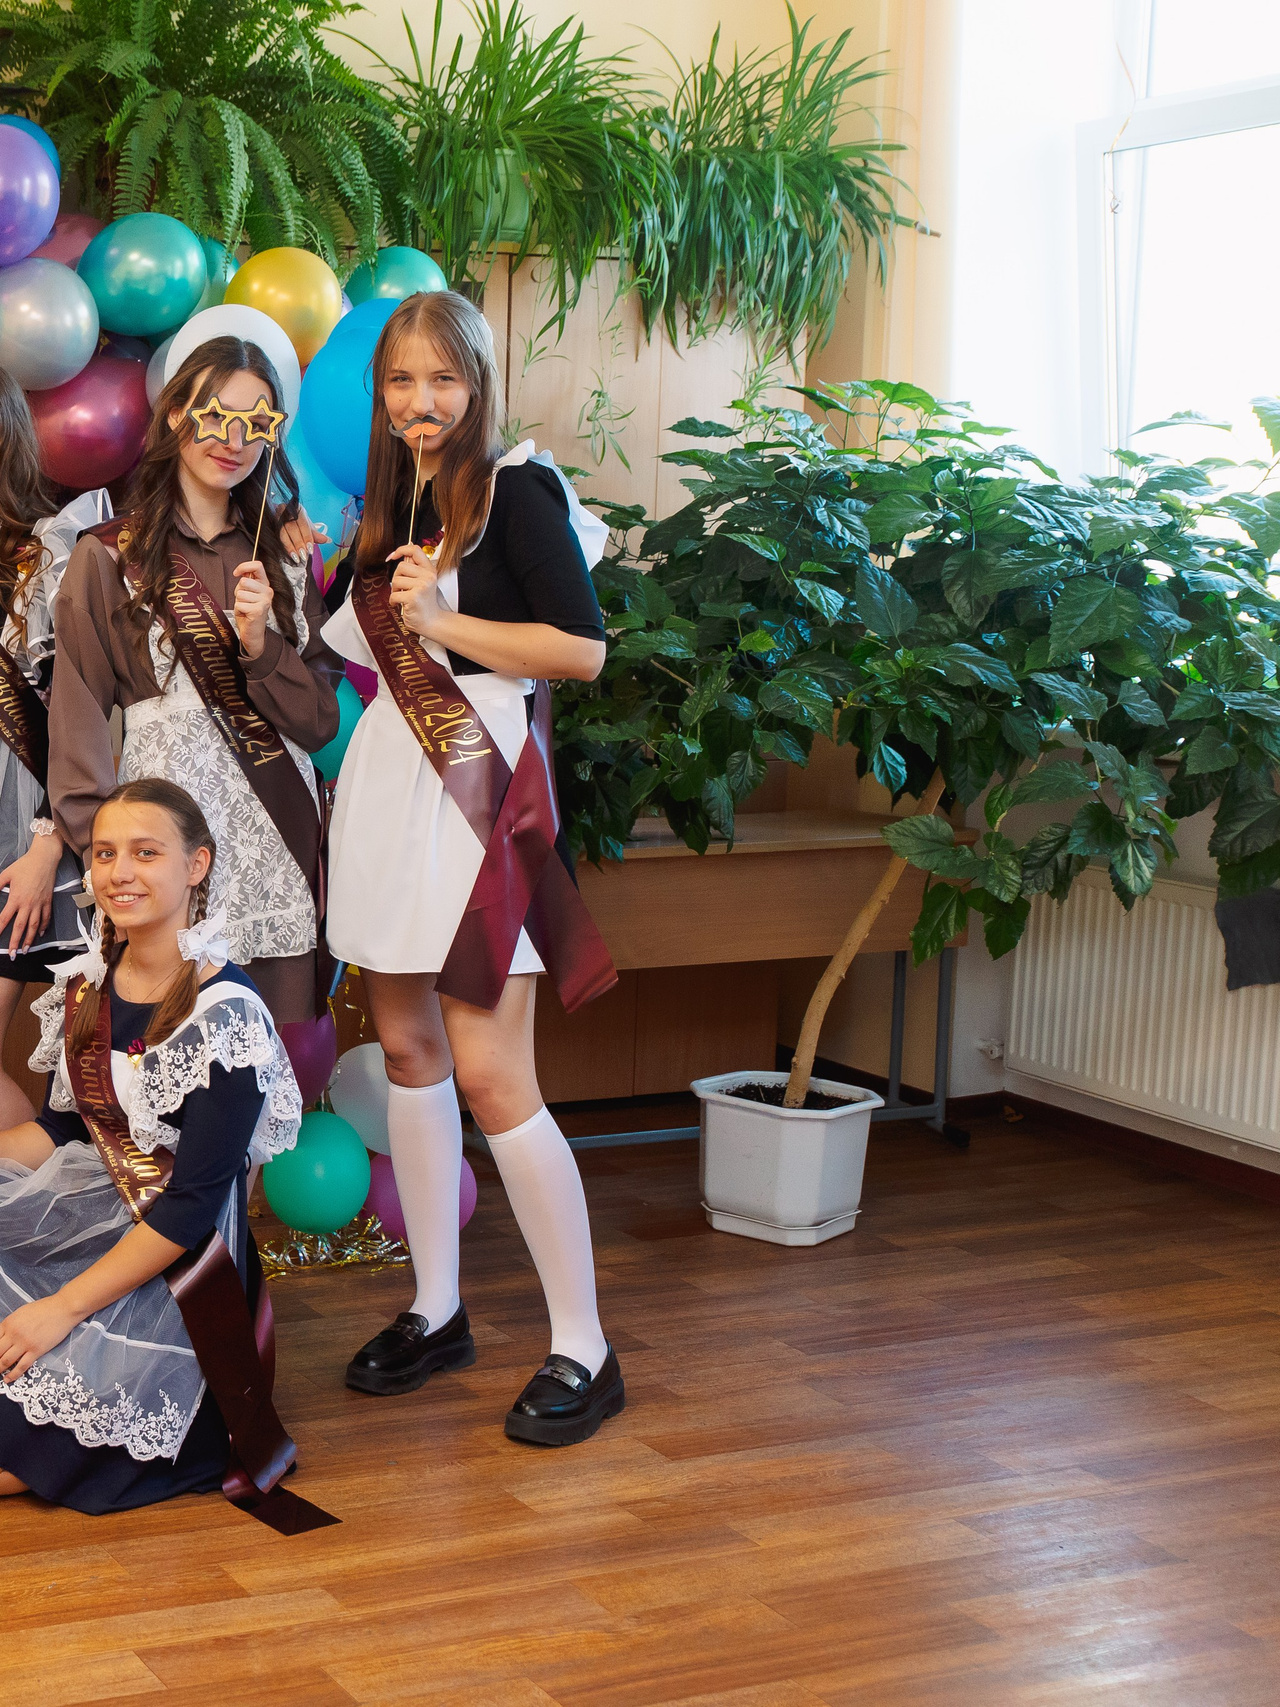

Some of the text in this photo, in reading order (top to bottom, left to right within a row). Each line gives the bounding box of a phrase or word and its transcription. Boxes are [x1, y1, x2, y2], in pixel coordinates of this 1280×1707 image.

[360, 573, 492, 766] Выпускница 2024
[211, 704, 240, 753] Кронштадт
[228, 710, 284, 767] 2024
[405, 704, 435, 753] Кронштадт
[117, 1175, 144, 1222] Кронштад
